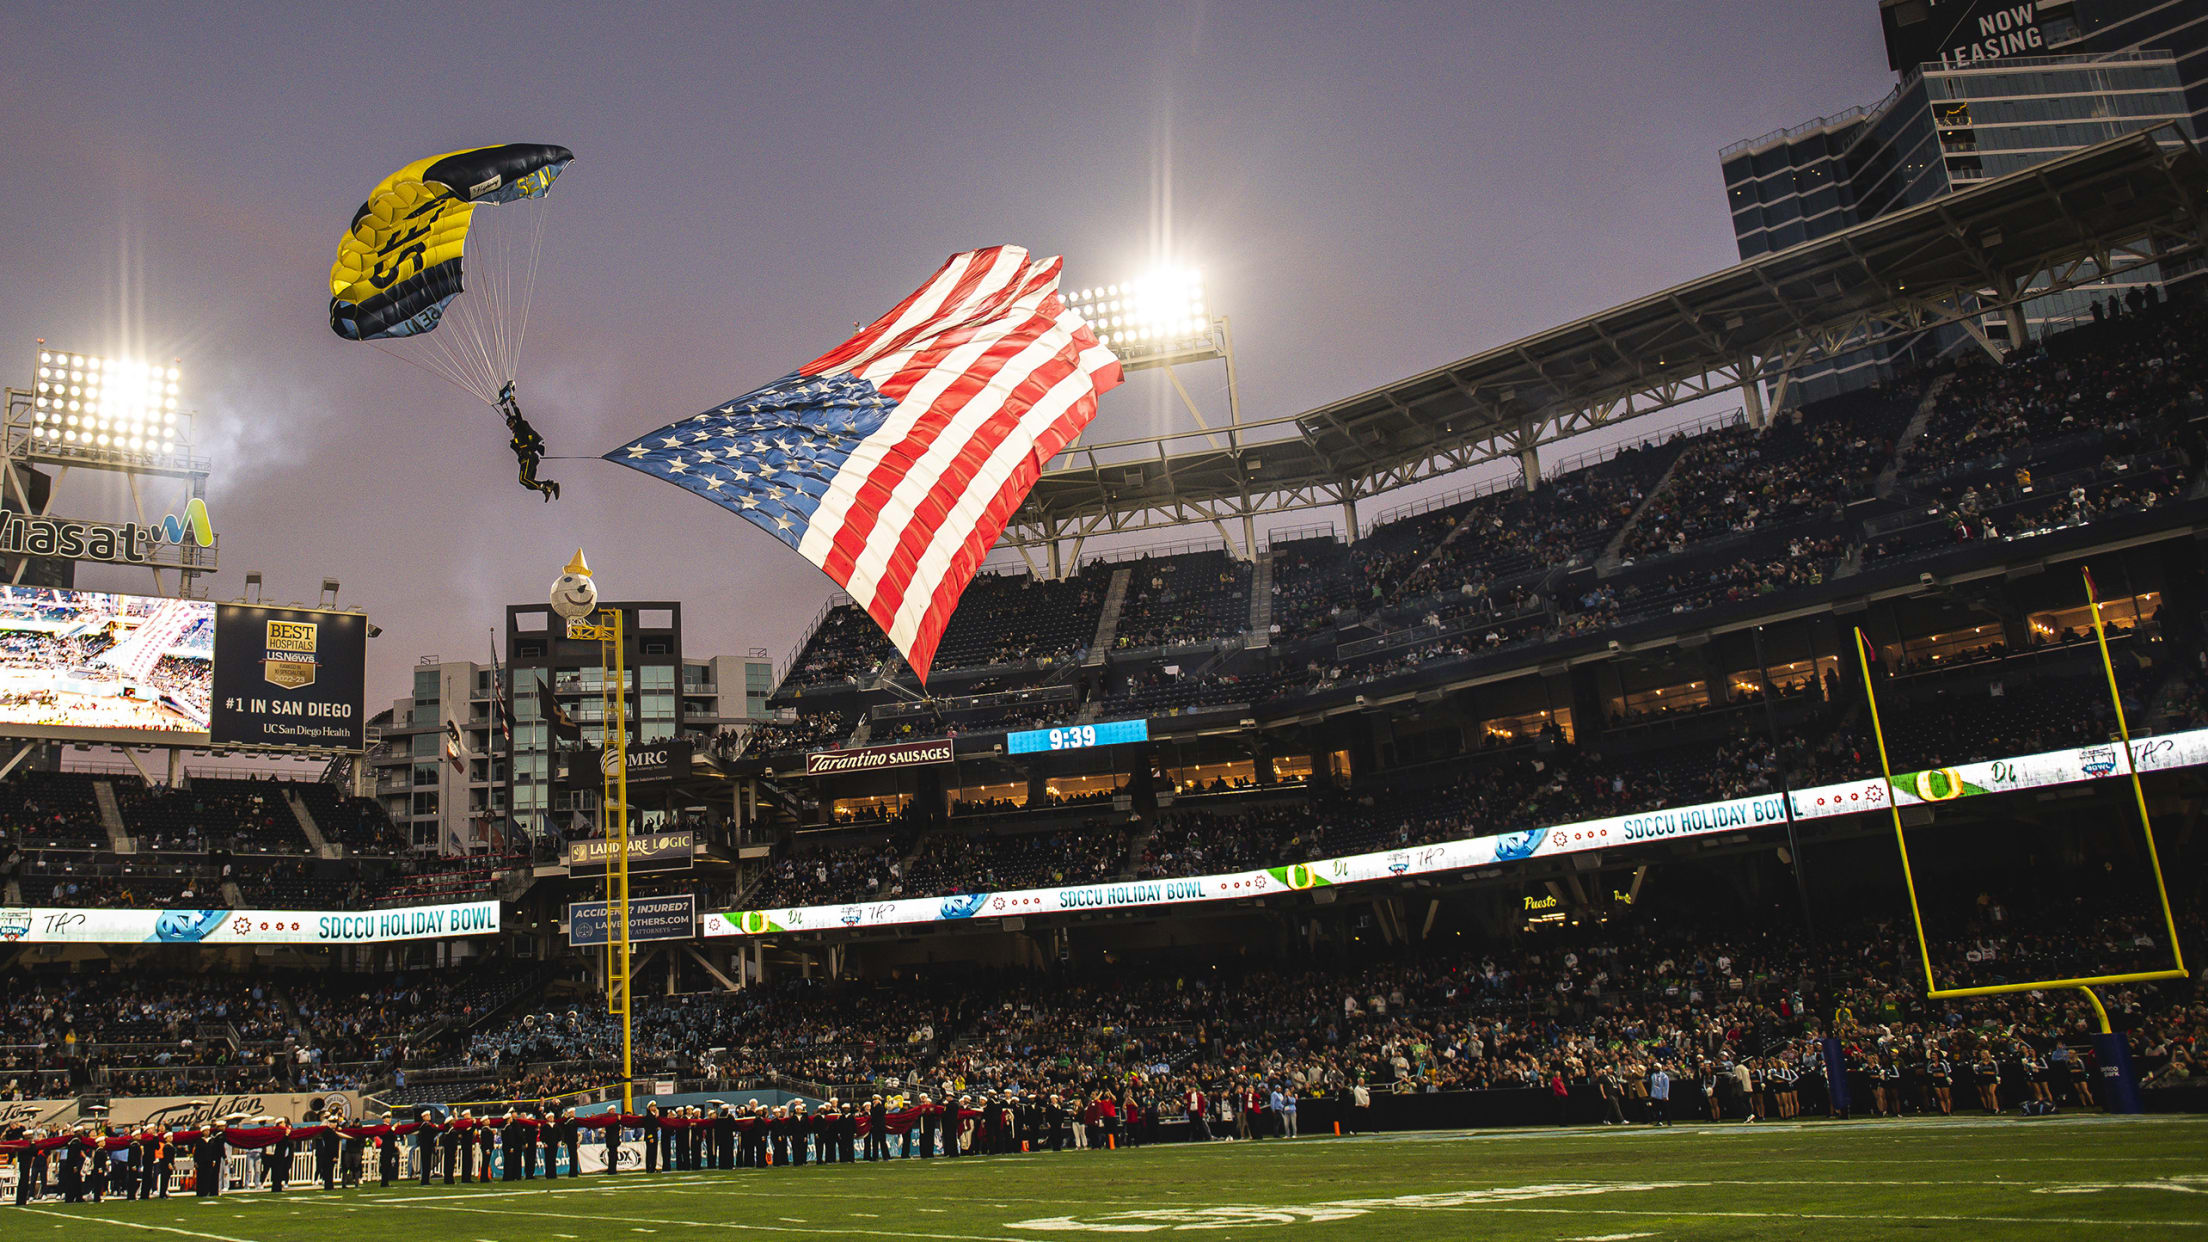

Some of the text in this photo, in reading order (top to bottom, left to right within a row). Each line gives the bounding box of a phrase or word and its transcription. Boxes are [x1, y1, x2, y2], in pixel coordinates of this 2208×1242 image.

[1979, 3, 2032, 36] NOW
[1941, 27, 2042, 70] LEASING
[517, 166, 556, 197] SEAL
[270, 624, 314, 640] BEST
[269, 639, 314, 651] HOSPITALS
[225, 697, 352, 718] #1 IN SAN DIEGO
[263, 723, 350, 737] UC San Diego Health
[1049, 725, 1096, 750] 9:39
[628, 751, 668, 767] MRC
[810, 748, 950, 771] Tarantino SAUSAGES
[1624, 815, 1675, 840] SDCCU
[1681, 804, 1748, 832] HOLIDAY
[590, 839, 648, 855] LANDARE
[1060, 881, 1206, 908] SDCCU HOLIDAY BOWL
[1523, 895, 1557, 911] Puesto
[575, 902, 689, 918] ACCIDEN? INJURED?
[319, 906, 496, 939] SDCCU HOLIDAY BOWL
[595, 916, 689, 929] LAWBOTHERS.COM
[634, 928, 671, 936] ATTORNEYS
